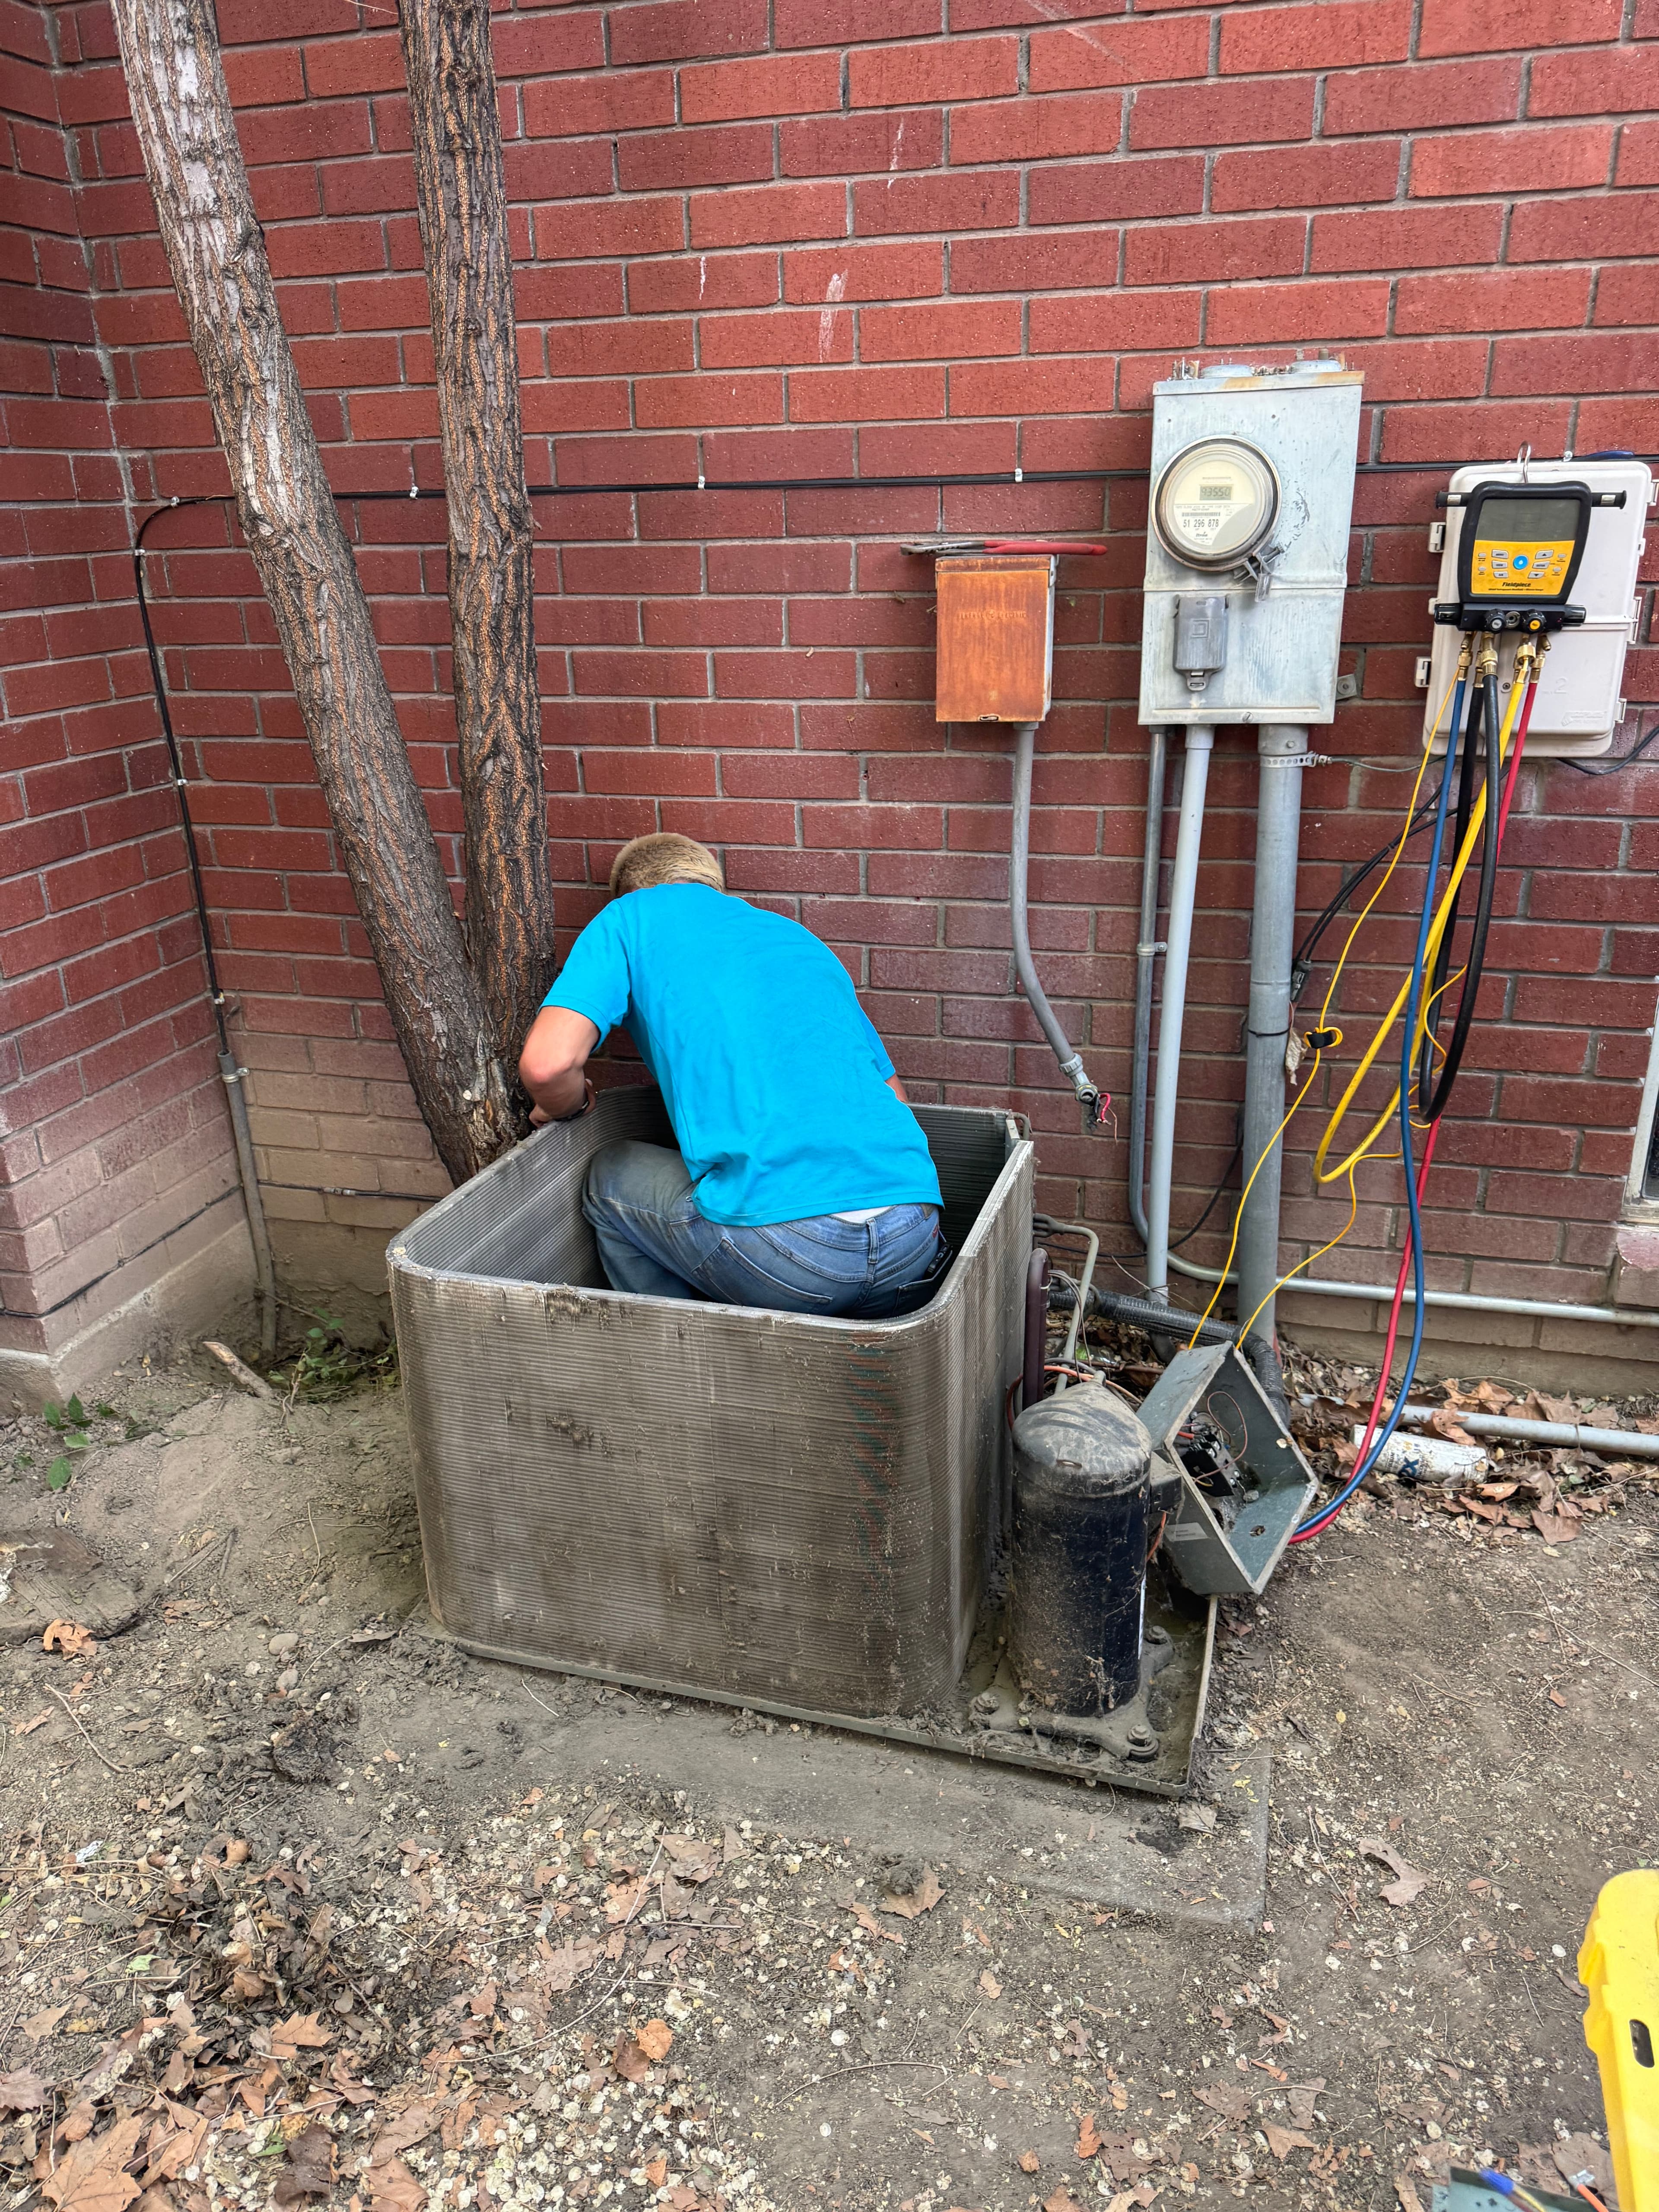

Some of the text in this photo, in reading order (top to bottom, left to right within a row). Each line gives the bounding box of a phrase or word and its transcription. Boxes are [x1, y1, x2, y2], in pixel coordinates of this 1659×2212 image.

[1183, 519, 1219, 528] 51 296 878
